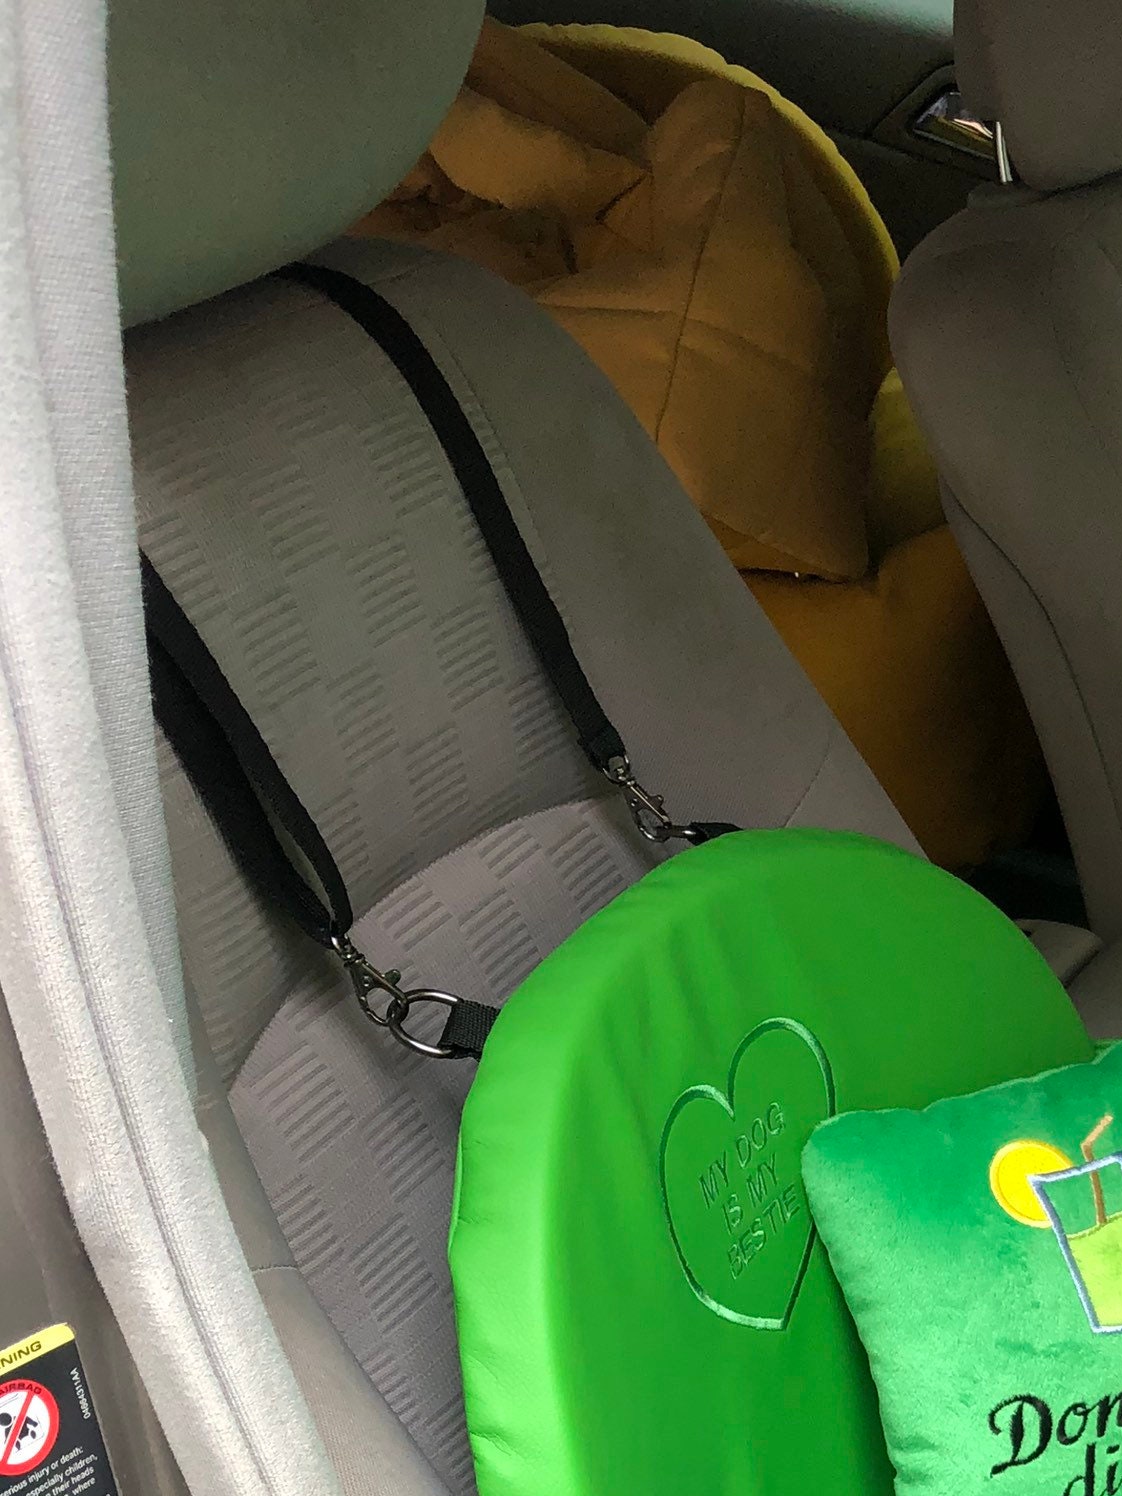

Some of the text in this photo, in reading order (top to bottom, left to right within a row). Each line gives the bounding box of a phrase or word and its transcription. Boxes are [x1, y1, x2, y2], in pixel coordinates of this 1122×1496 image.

[698, 1101, 785, 1209] MY DOG
[722, 1153, 779, 1235] IS MY
[726, 1183, 800, 1280] BESTIE
[0, 1341, 42, 1369] NING
[27, 1466, 49, 1482] injury
[50, 1460, 58, 1469] or
[60, 1446, 83, 1464] death:
[64, 1454, 97, 1476] children,
[52, 1480, 69, 1495] their
[70, 1466, 93, 1483] heads
[72, 1477, 94, 1495] where
